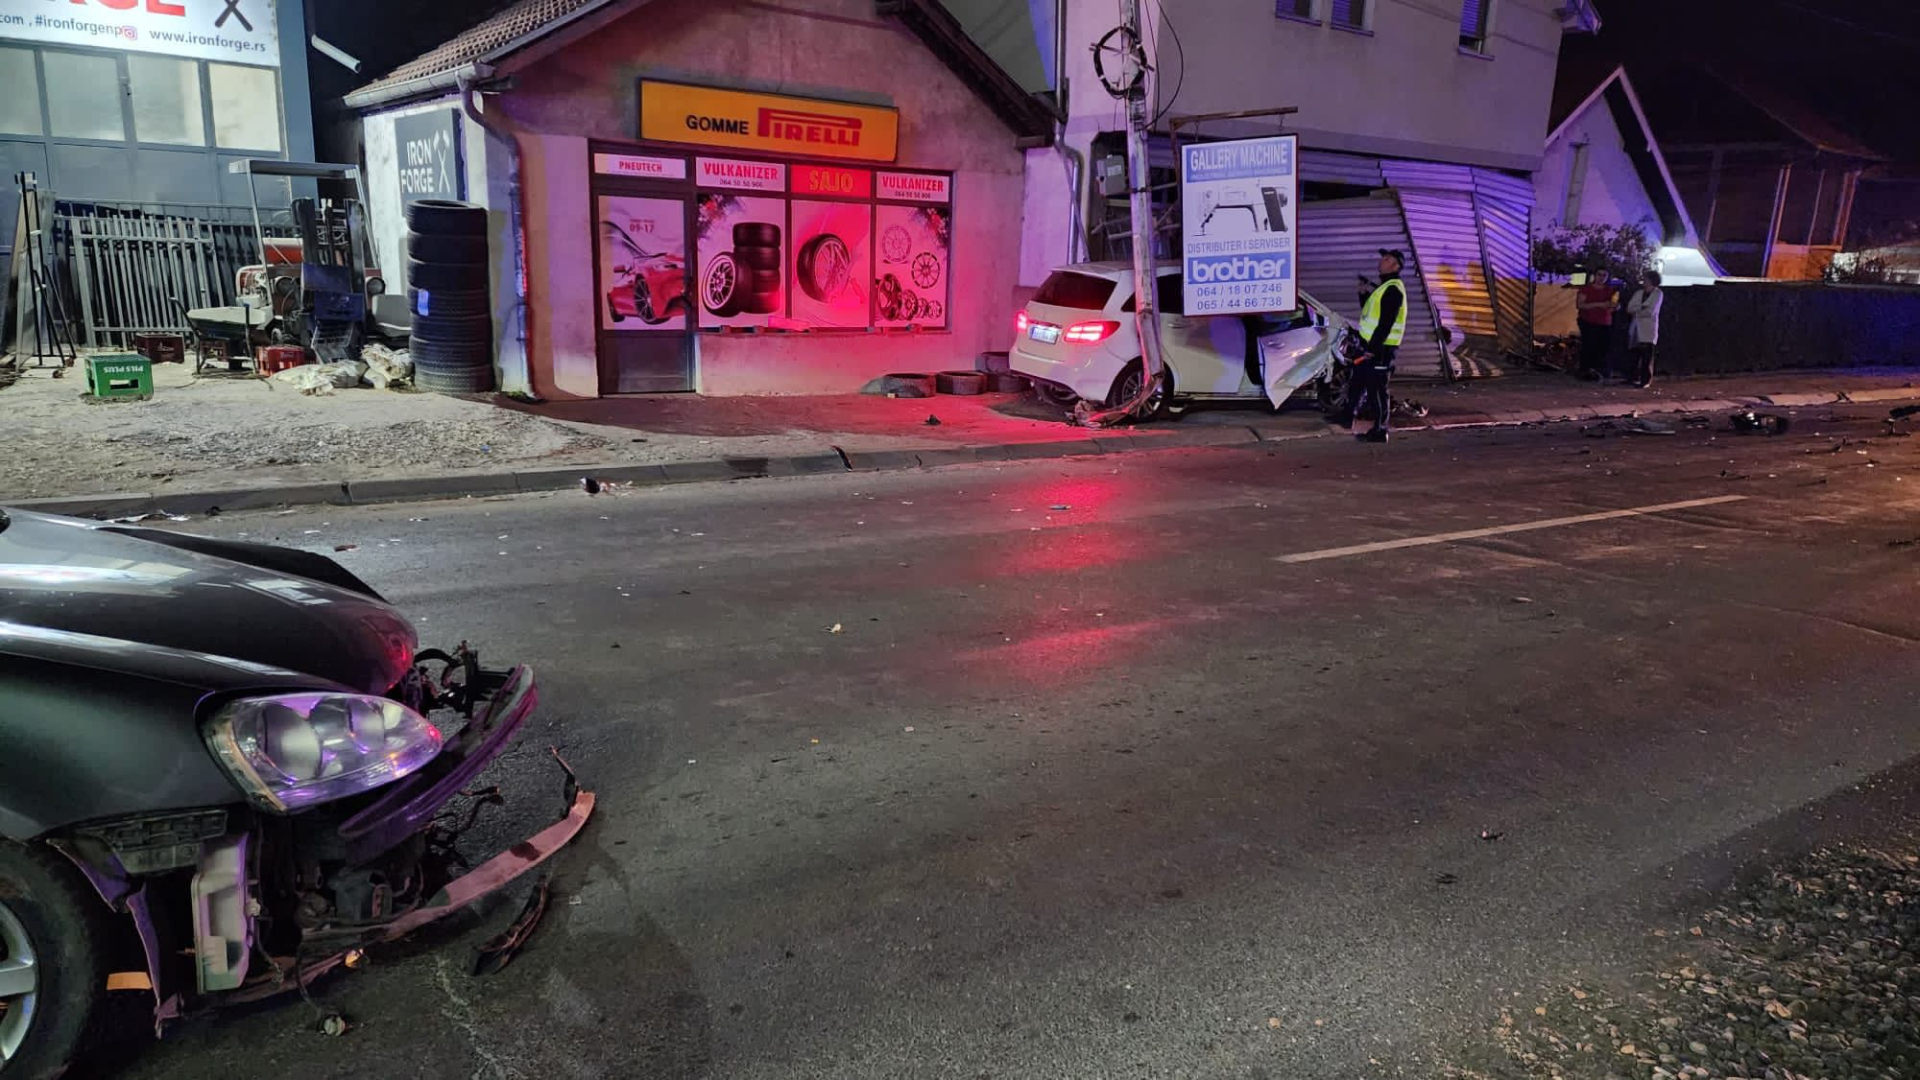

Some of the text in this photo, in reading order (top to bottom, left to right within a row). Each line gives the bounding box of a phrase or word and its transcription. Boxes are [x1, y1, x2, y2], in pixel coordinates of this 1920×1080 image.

[149, 30, 266, 52] www.ironforge.rs
[686, 107, 862, 146] GOMME PIRELLI
[406, 138, 432, 166] IRON
[1190, 143, 1288, 171] GALLERY MACHINE
[619, 161, 662, 173] PNEUTECH
[704, 162, 778, 180] VULKANIZER
[400, 167, 434, 193] FORGE
[809, 169, 853, 192] SAJO
[882, 176, 944, 193] VULKANIZER
[1187, 240, 1240, 254] DISTRIBUTER
[1249, 237, 1290, 250] SERVISER
[1192, 257, 1286, 282] brother
[1197, 287, 1217, 297] 064
[1229, 285, 1240, 295] 18
[1244, 284, 1258, 294] 07
[1261, 283, 1282, 293] 246
[1197, 300, 1217, 310] 065
[1227, 299, 1240, 308] 44
[1261, 297, 1282, 307] 738
[125, 365, 144, 373] PILS
